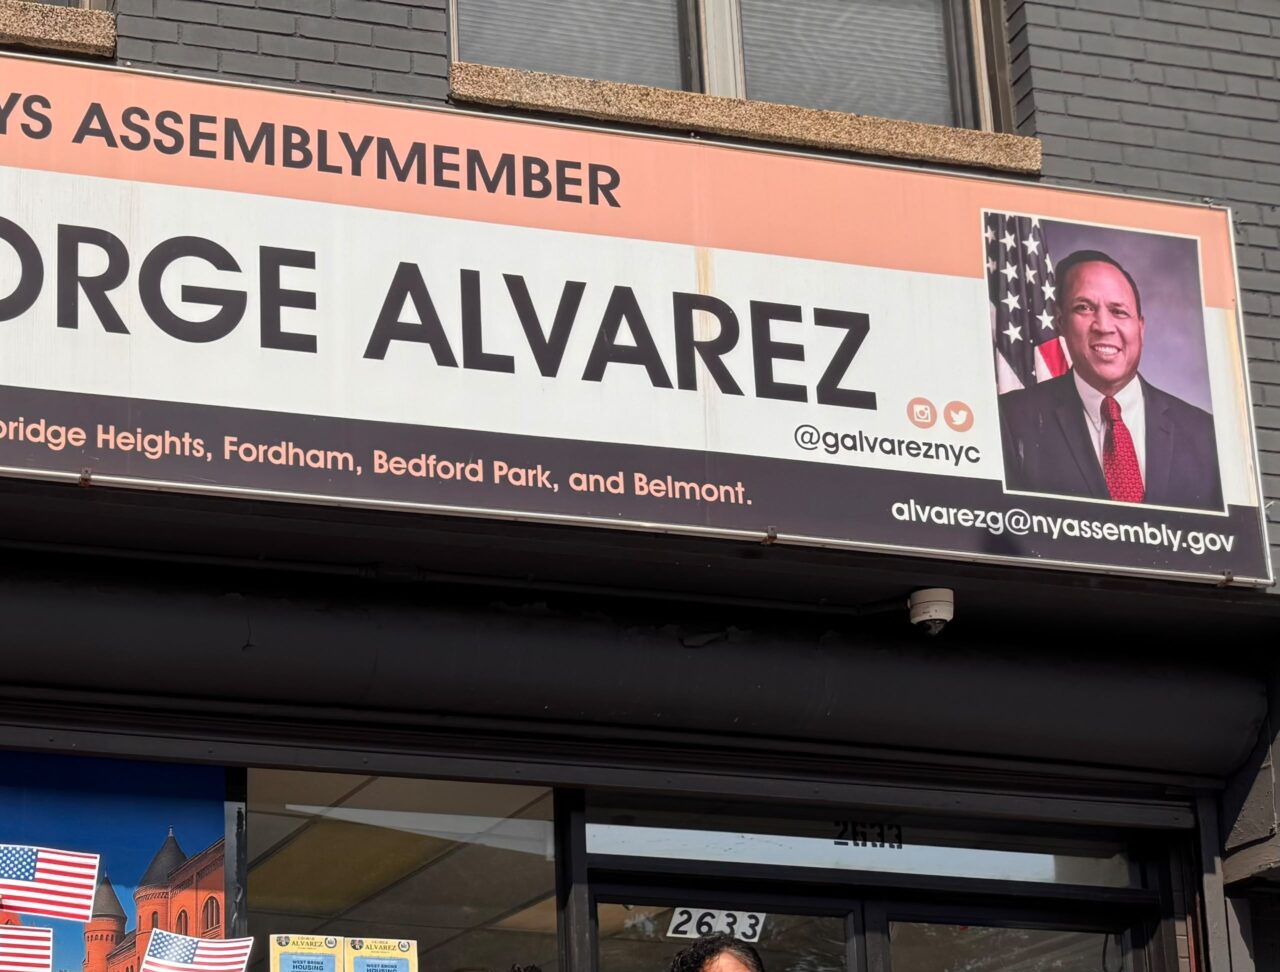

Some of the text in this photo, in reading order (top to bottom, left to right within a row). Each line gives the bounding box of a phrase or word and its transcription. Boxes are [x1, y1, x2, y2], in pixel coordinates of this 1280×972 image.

[72, 103, 622, 208] ASSEMBLYMEMBER
[362, 262, 878, 411] ALVAREZ
[96, 424, 213, 463] Heights,
[223, 436, 362, 474] Fordham,
[373, 450, 484, 483] Bedford
[493, 460, 560, 493] Park,
[568, 468, 626, 493] and
[634, 472, 753, 507] Belmont.
[793, 423, 982, 466] @galvareznyc
[891, 498, 1235, 557] alvarezg@nyassembly.gov
[834, 821, 903, 850] 2633
[671, 909, 761, 940] 2633
